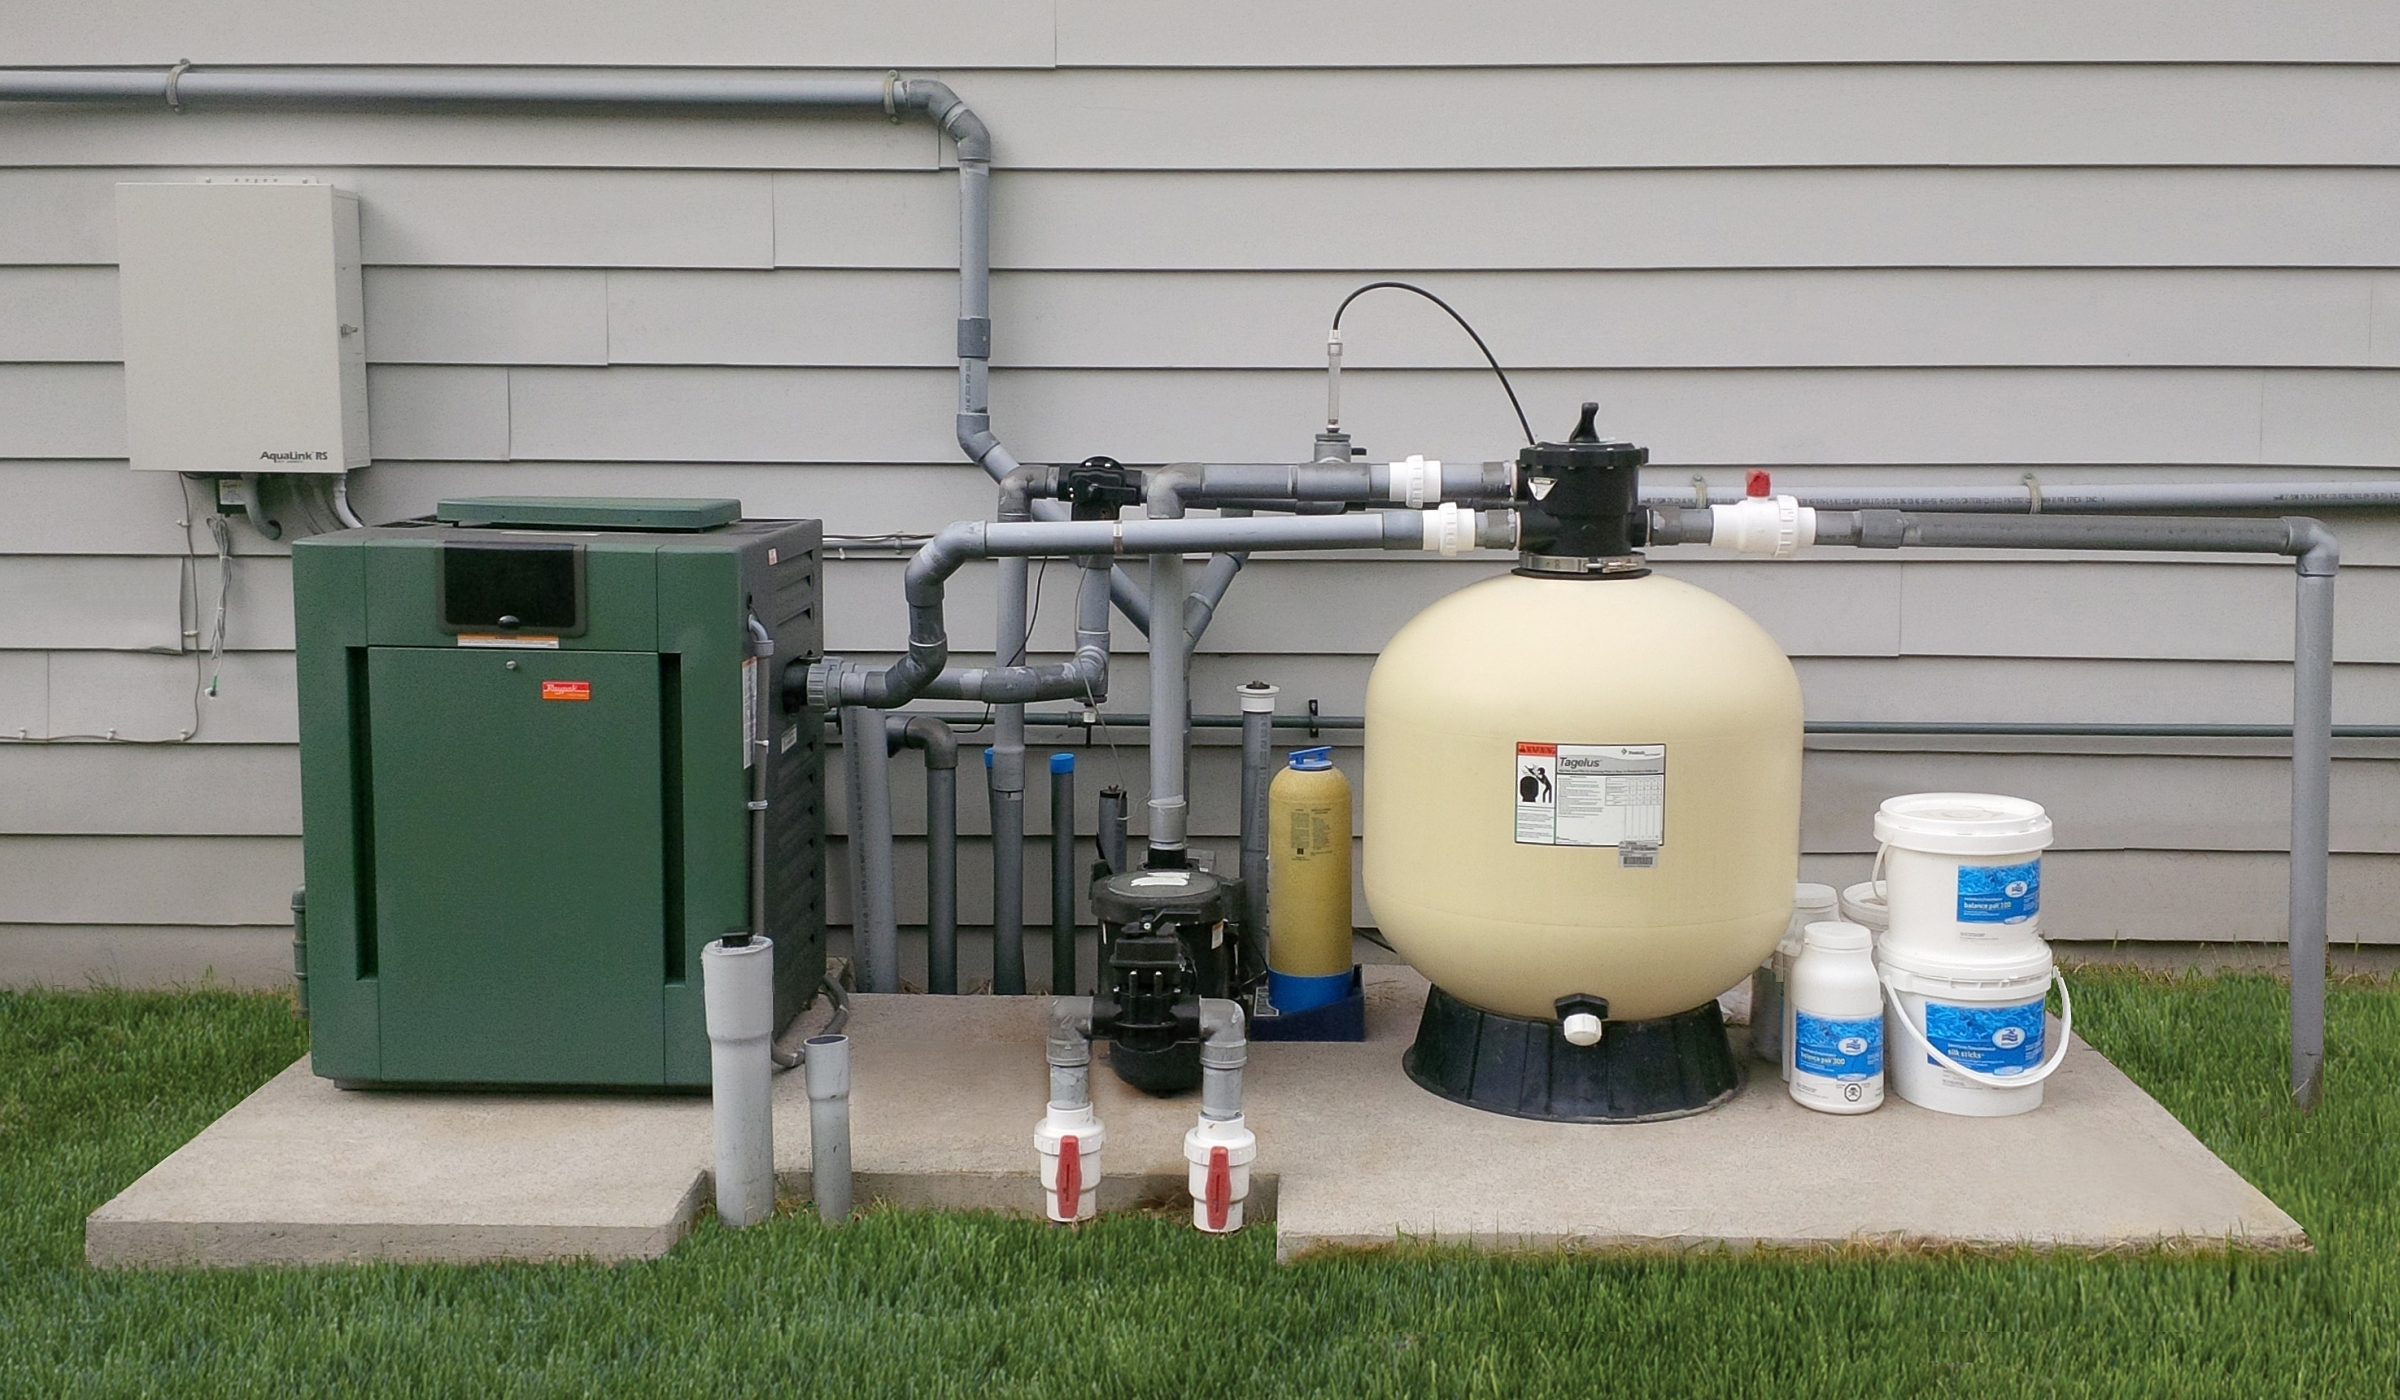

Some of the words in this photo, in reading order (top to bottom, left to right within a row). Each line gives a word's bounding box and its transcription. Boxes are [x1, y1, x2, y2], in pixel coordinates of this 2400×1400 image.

[260, 451, 312, 463] AquaLink
[315, 451, 328, 460] RS
[1560, 757, 1600, 769] Tagelus
[1964, 901, 1988, 909] balance
[1948, 1048, 1960, 1057] silk
